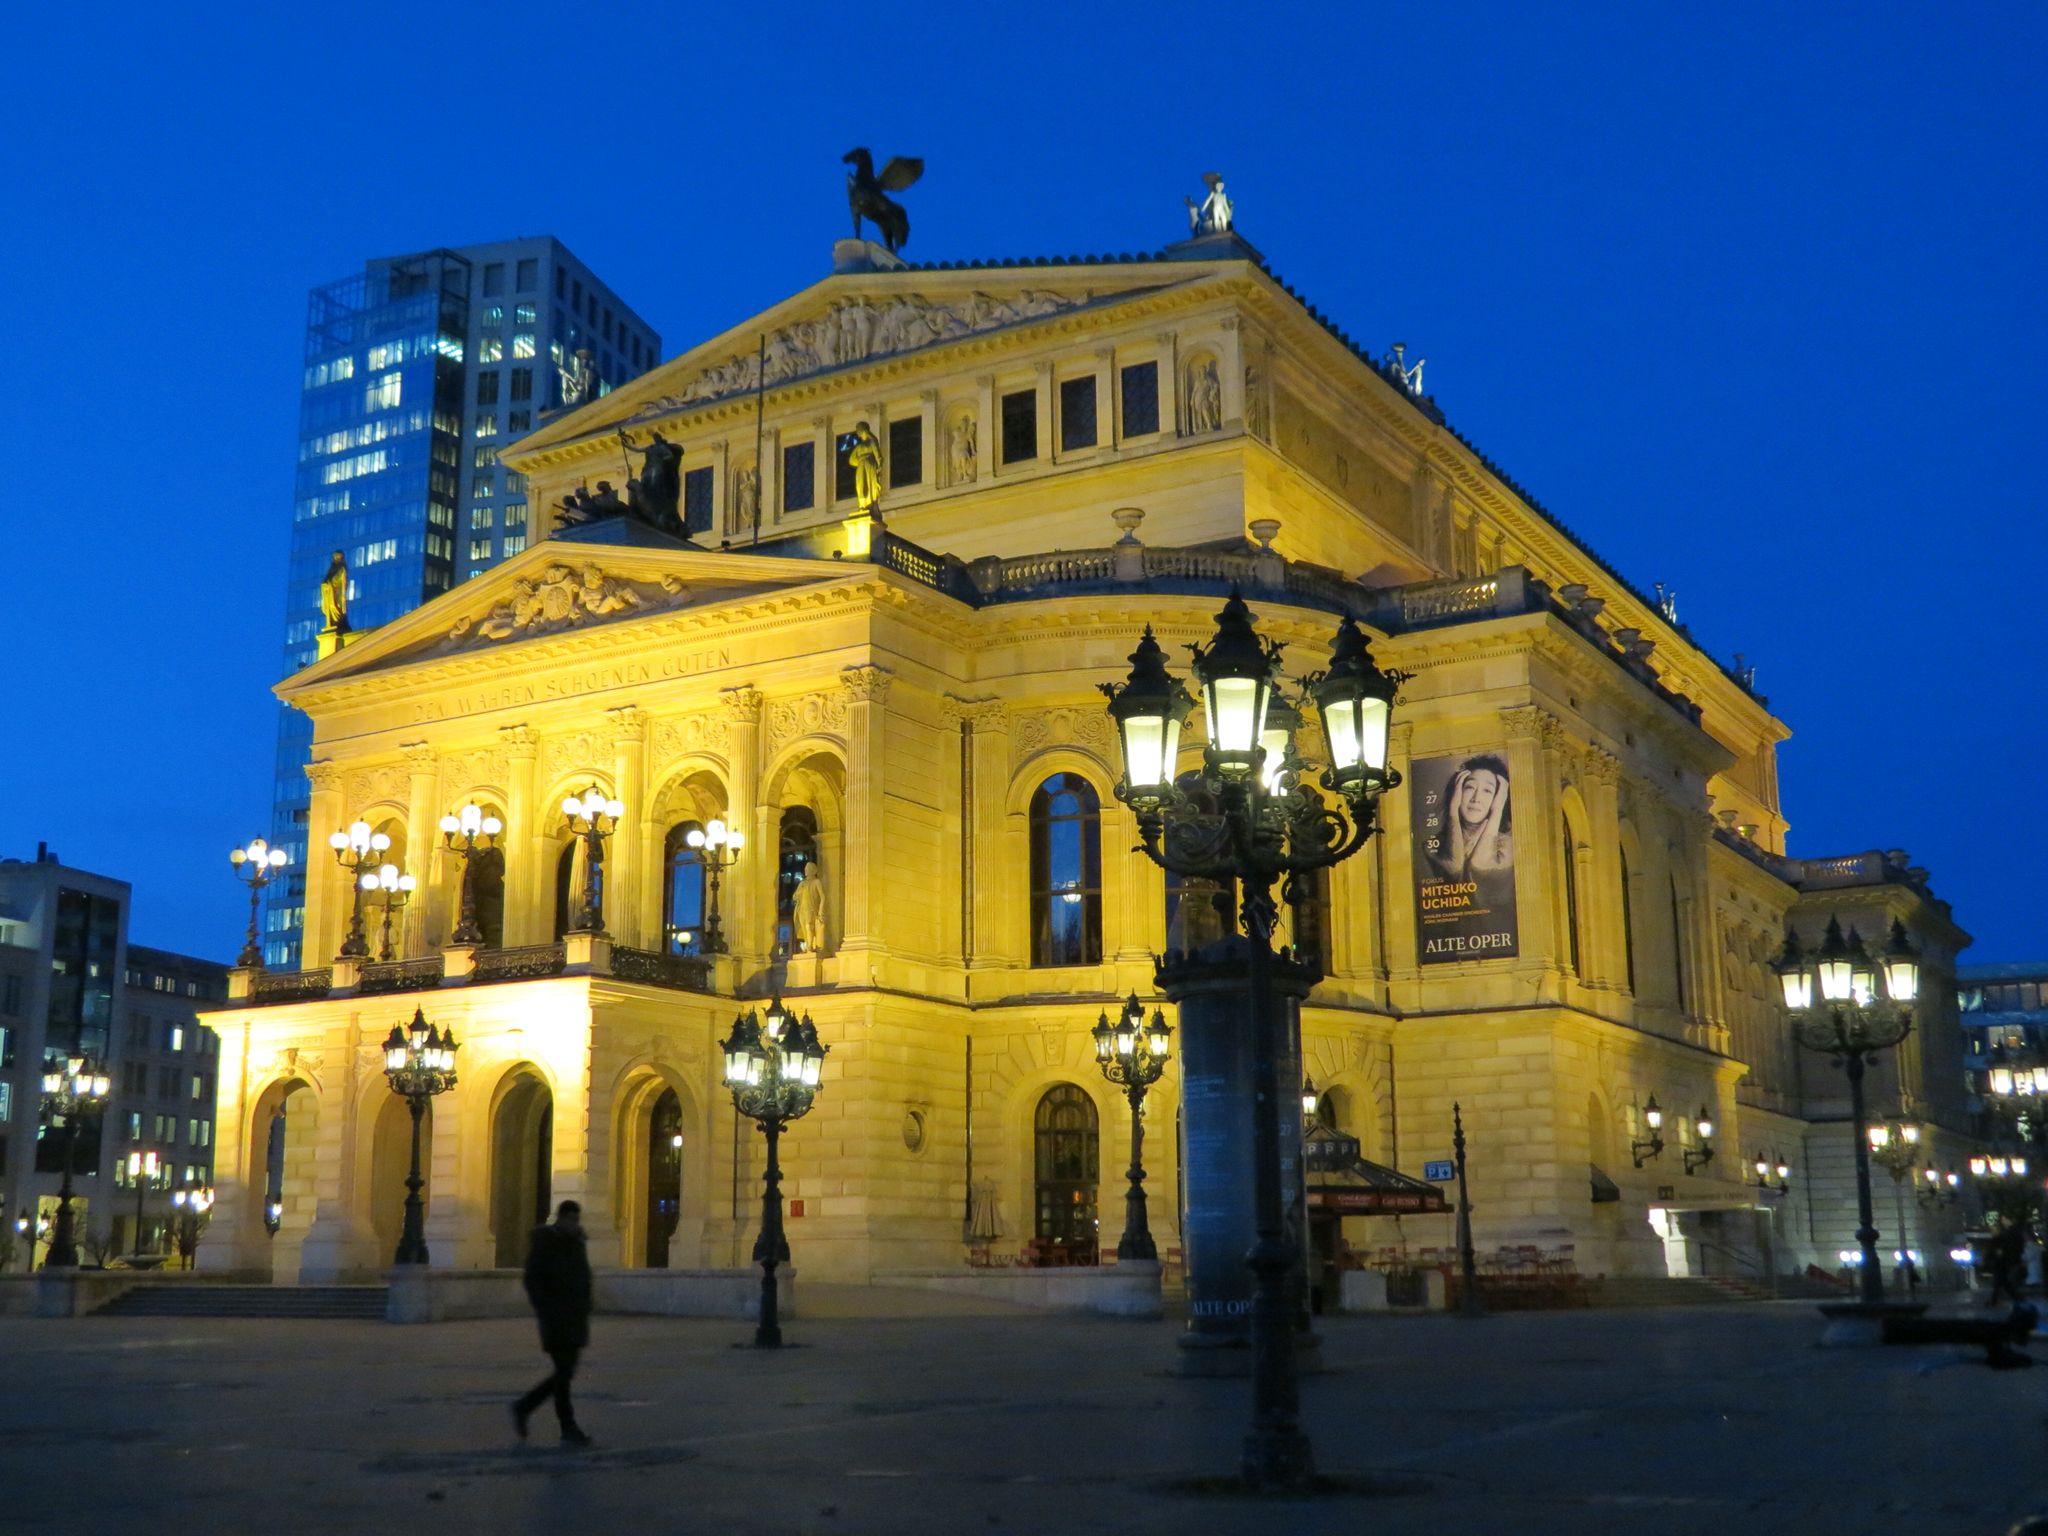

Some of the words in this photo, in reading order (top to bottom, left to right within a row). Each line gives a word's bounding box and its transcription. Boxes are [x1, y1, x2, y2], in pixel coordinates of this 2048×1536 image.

[458, 684, 535, 713] WAHREN
[546, 663, 650, 697] SCHOENEN
[1426, 794, 1437, 804] 27
[1426, 817, 1439, 827] 28
[1427, 839, 1440, 849] 30
[1422, 882, 1478, 897] MITSUKO
[1422, 895, 1471, 909] UCHIDA
[1426, 936, 1466, 953] ALTE
[1469, 932, 1512, 950] OPER
